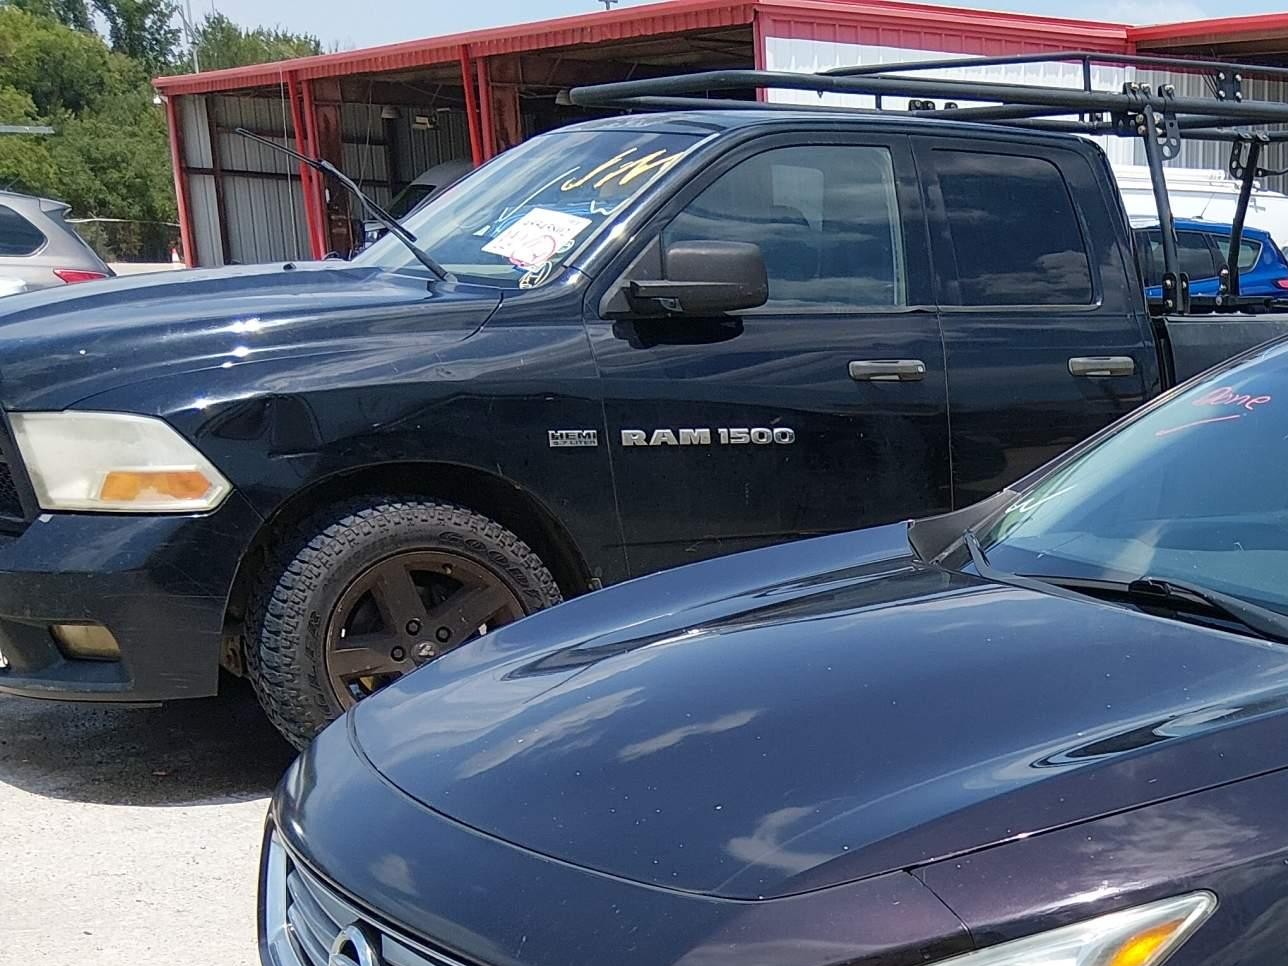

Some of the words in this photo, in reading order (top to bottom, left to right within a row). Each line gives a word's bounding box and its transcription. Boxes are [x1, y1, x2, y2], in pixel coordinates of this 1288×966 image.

[549, 430, 598, 441] HEMI
[621, 428, 711, 446] RAM
[718, 428, 796, 445] 1500
